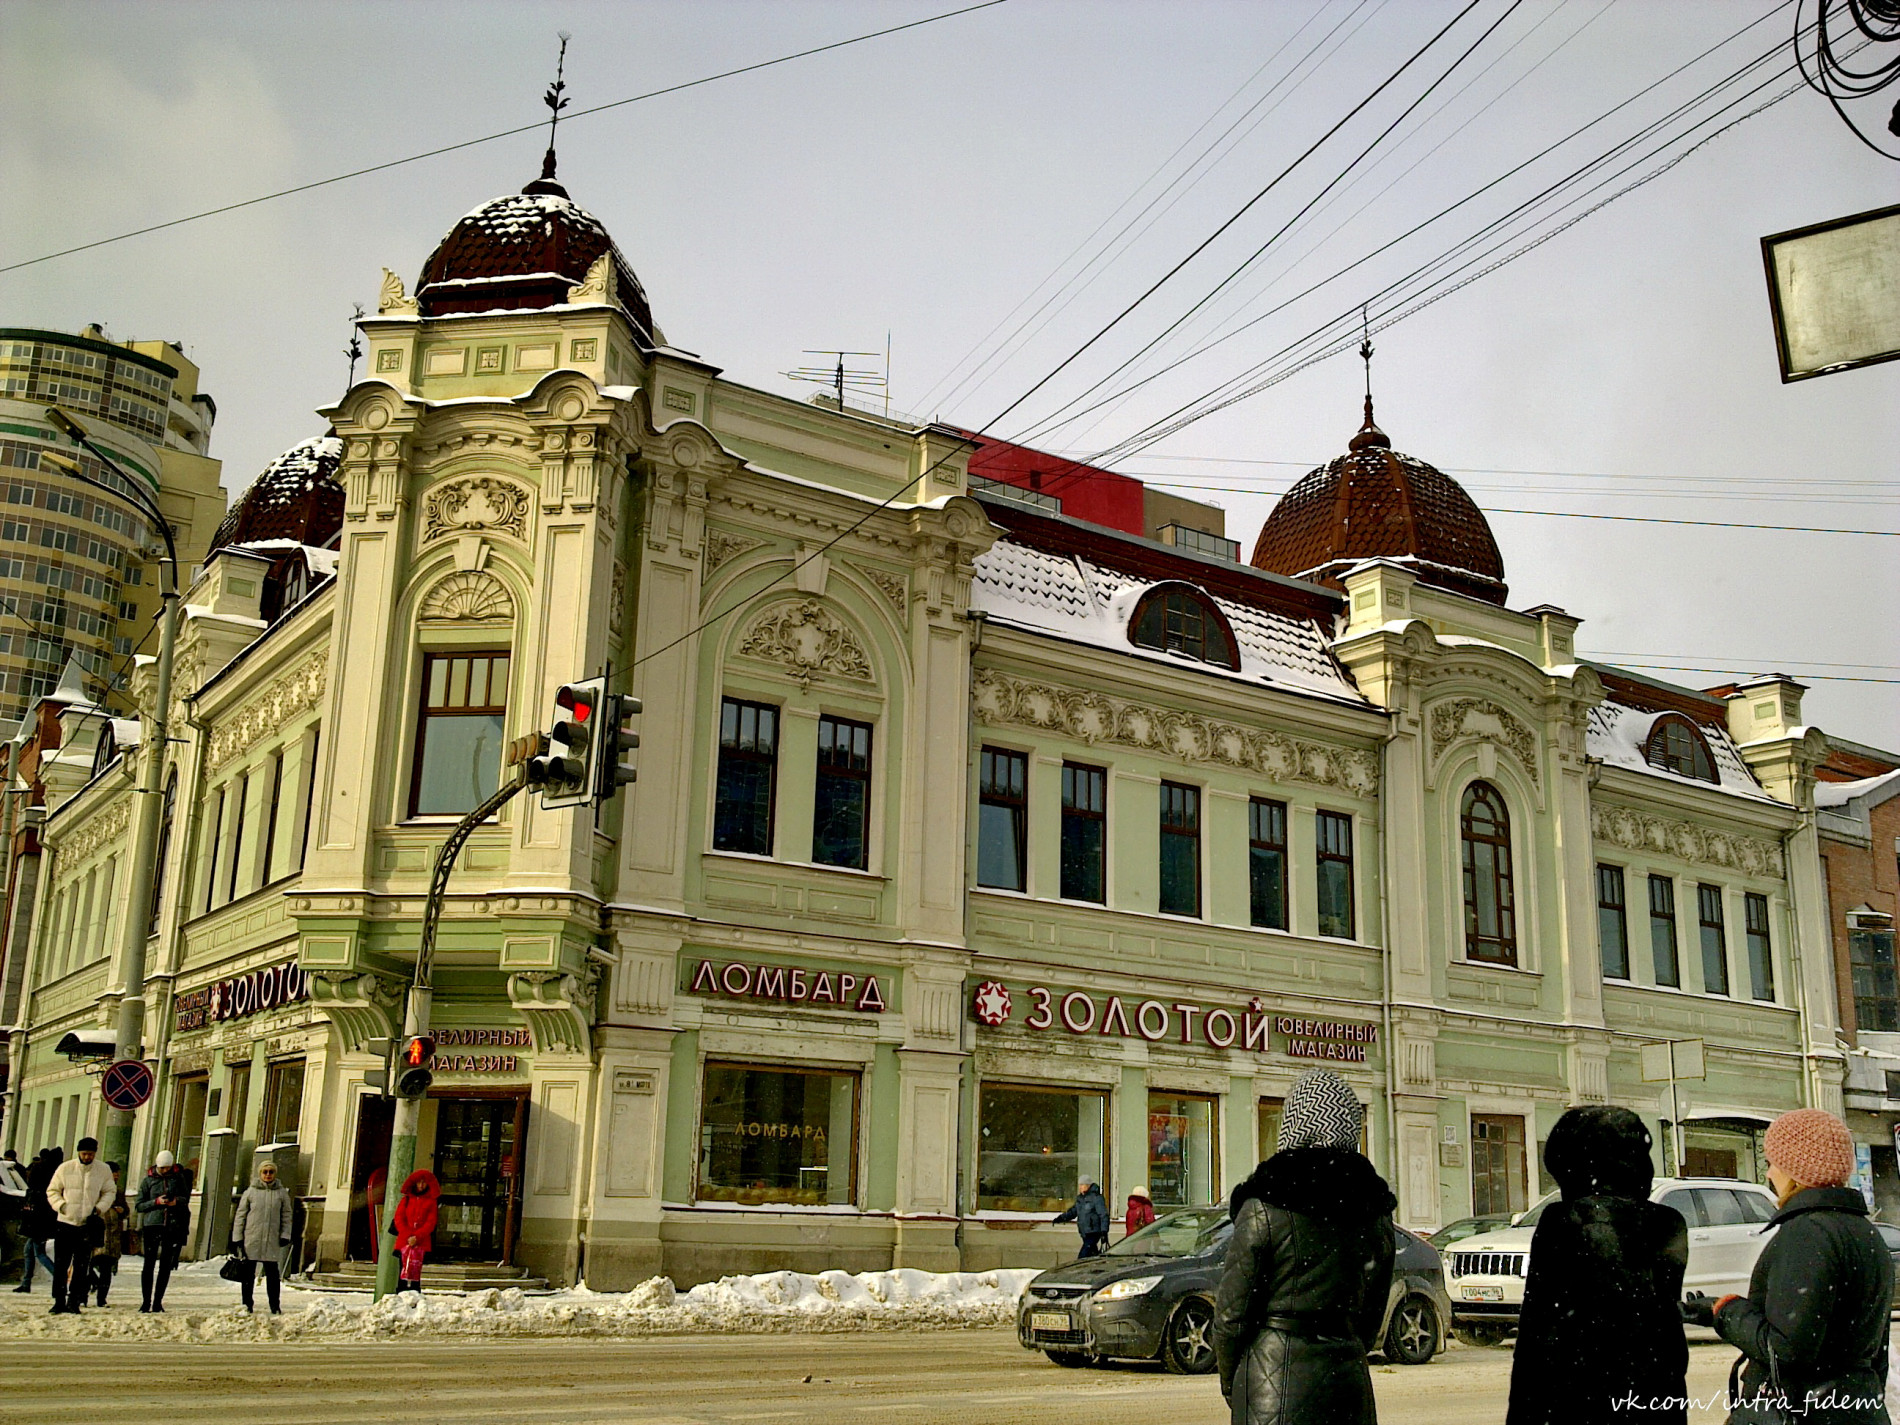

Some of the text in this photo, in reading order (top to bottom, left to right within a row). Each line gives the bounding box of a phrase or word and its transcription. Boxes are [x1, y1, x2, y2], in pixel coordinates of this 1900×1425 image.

[690, 959, 886, 1013] ЛОМБАРД
[1024, 986, 1270, 1053] ЗОЛОТОЙ
[1275, 1016, 1378, 1043] ЮВЕЛИРНЫЙ
[427, 1028, 532, 1046] ВЕЛИРНЫЙ
[1287, 1038, 1367, 1062] МАГАЗИН
[734, 1121, 826, 1142] ЛОМБАРД
